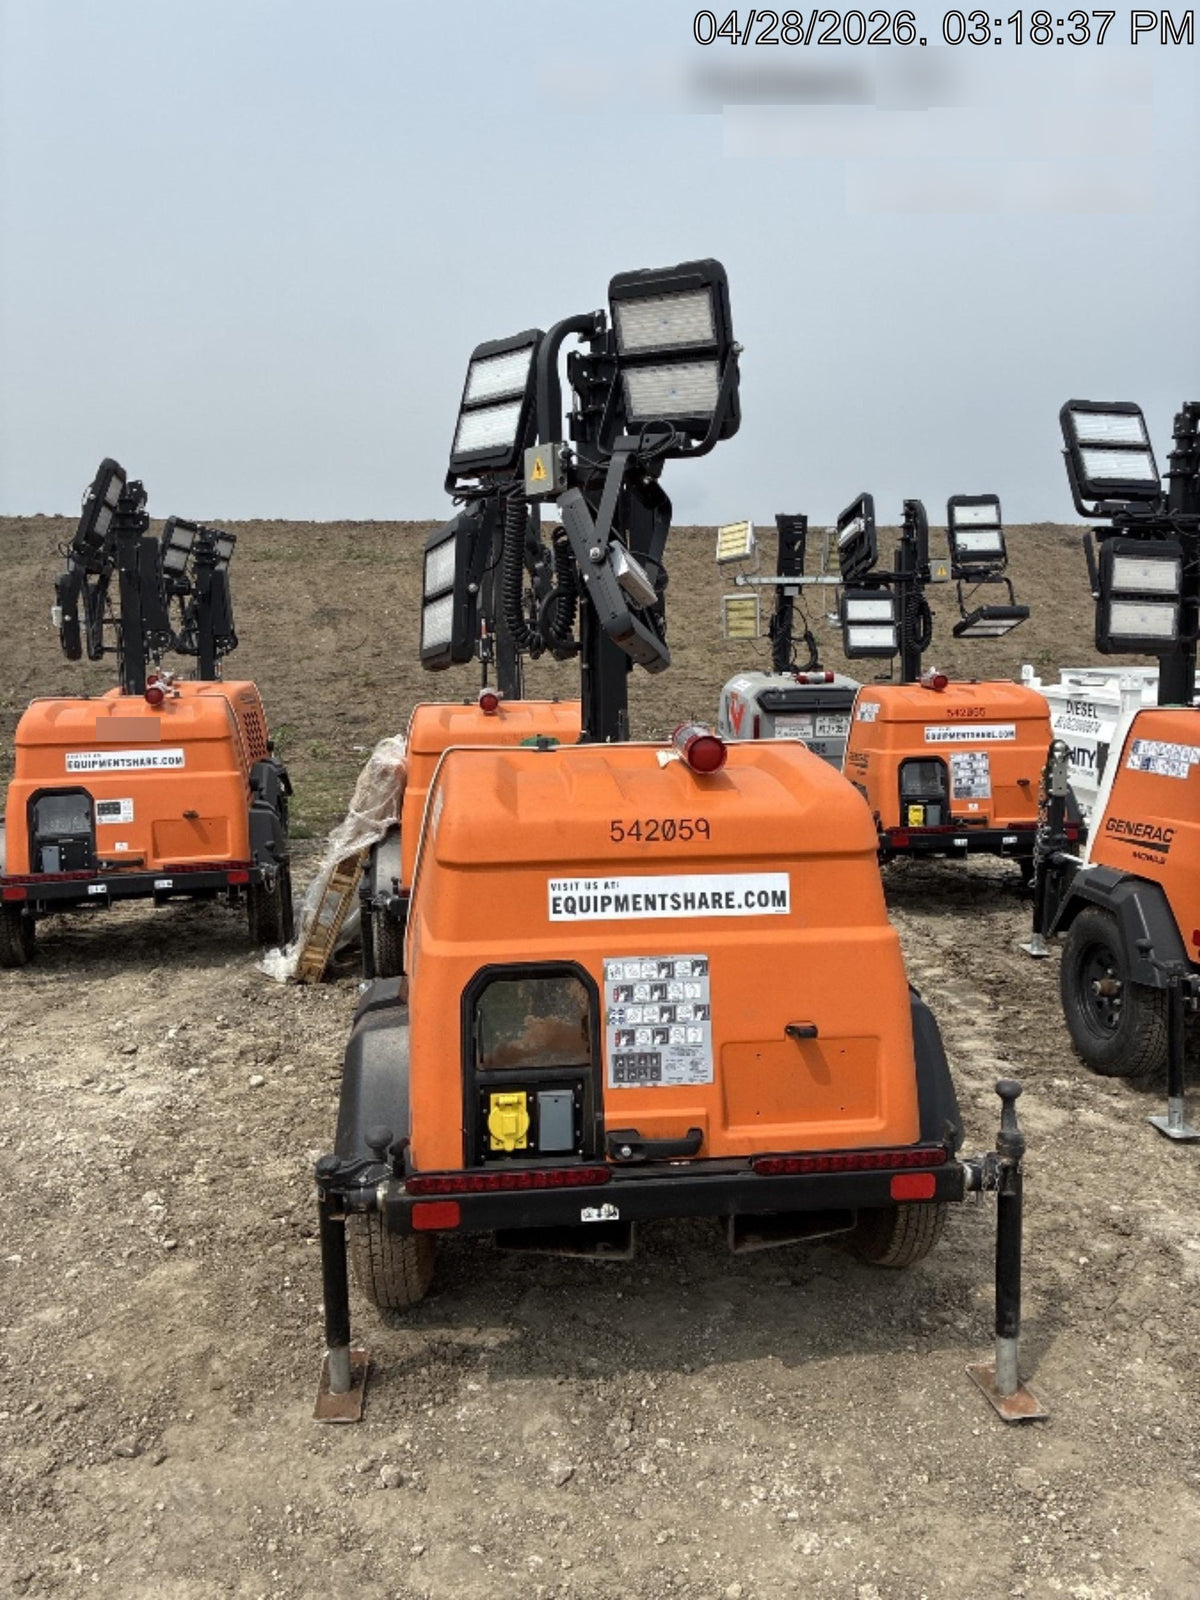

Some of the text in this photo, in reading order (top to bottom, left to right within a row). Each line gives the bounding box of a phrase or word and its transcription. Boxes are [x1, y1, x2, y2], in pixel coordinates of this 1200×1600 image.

[1066, 700, 1098, 719] DIESEL
[610, 818, 711, 843] 542059
[1105, 817, 1175, 843] GENERAC
[550, 881, 579, 891] VISIT
[585, 881, 598, 890] US
[551, 890, 787, 915] EQUIPMENTSHARE.COM
